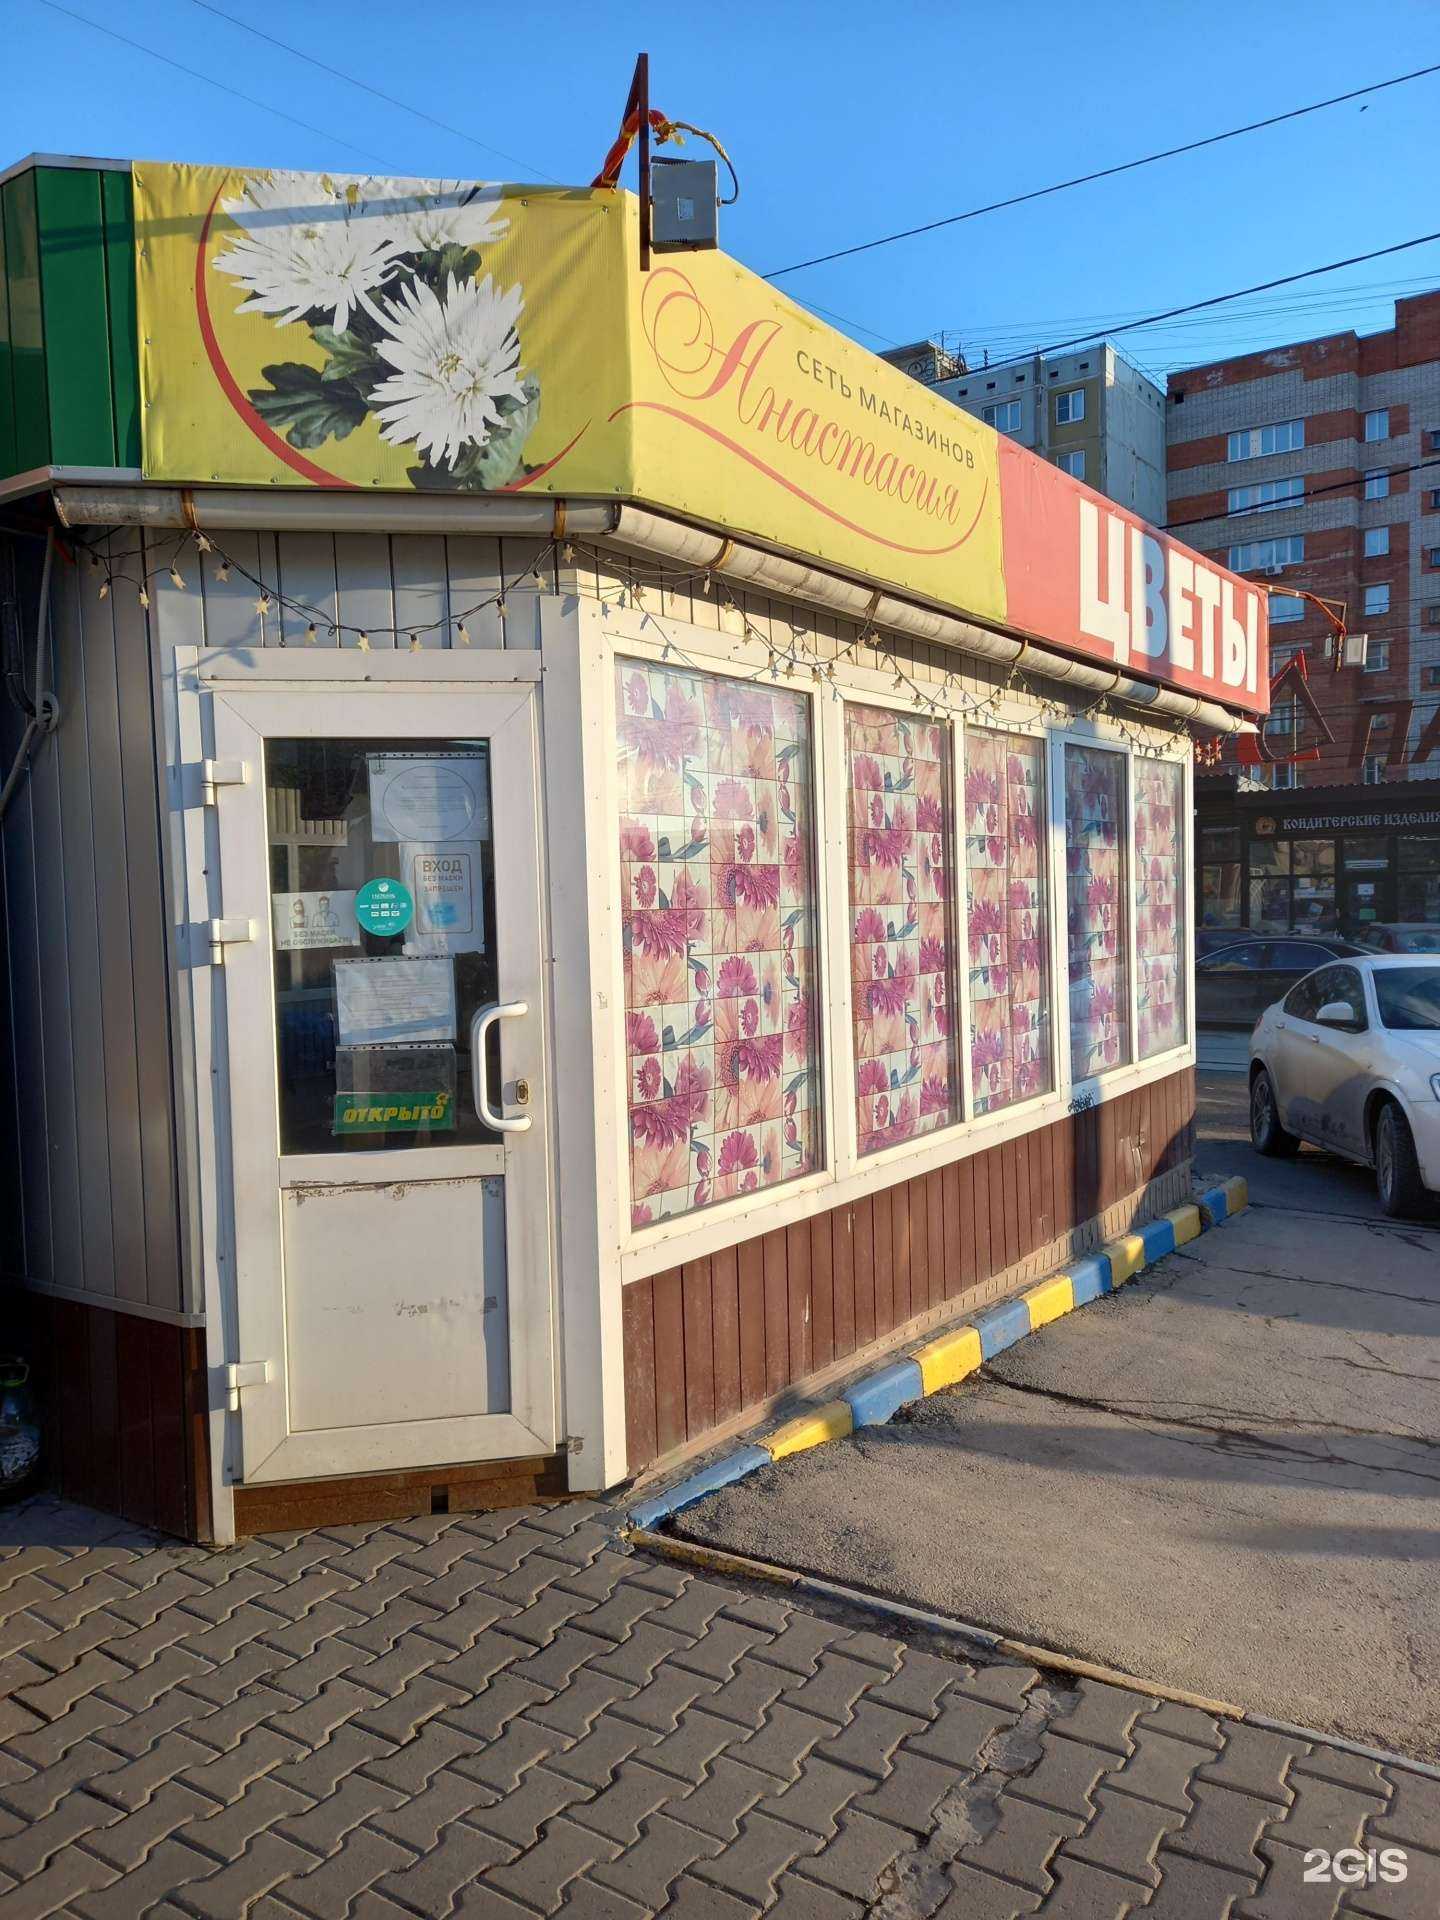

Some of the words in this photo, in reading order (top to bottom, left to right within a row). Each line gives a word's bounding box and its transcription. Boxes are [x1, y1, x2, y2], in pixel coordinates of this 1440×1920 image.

[641, 267, 961, 526] Анастасия
[796, 350, 852, 399] СЕТЬ
[859, 386, 975, 469] МАГАЗИНОВ
[1079, 497, 1259, 694] ЦВЕТЫ
[1282, 814, 1381, 830] КОНДИТЕРСКИЕ
[422, 860, 463, 874] ВХОД
[343, 1105, 445, 1124] ОТКРЫТО
